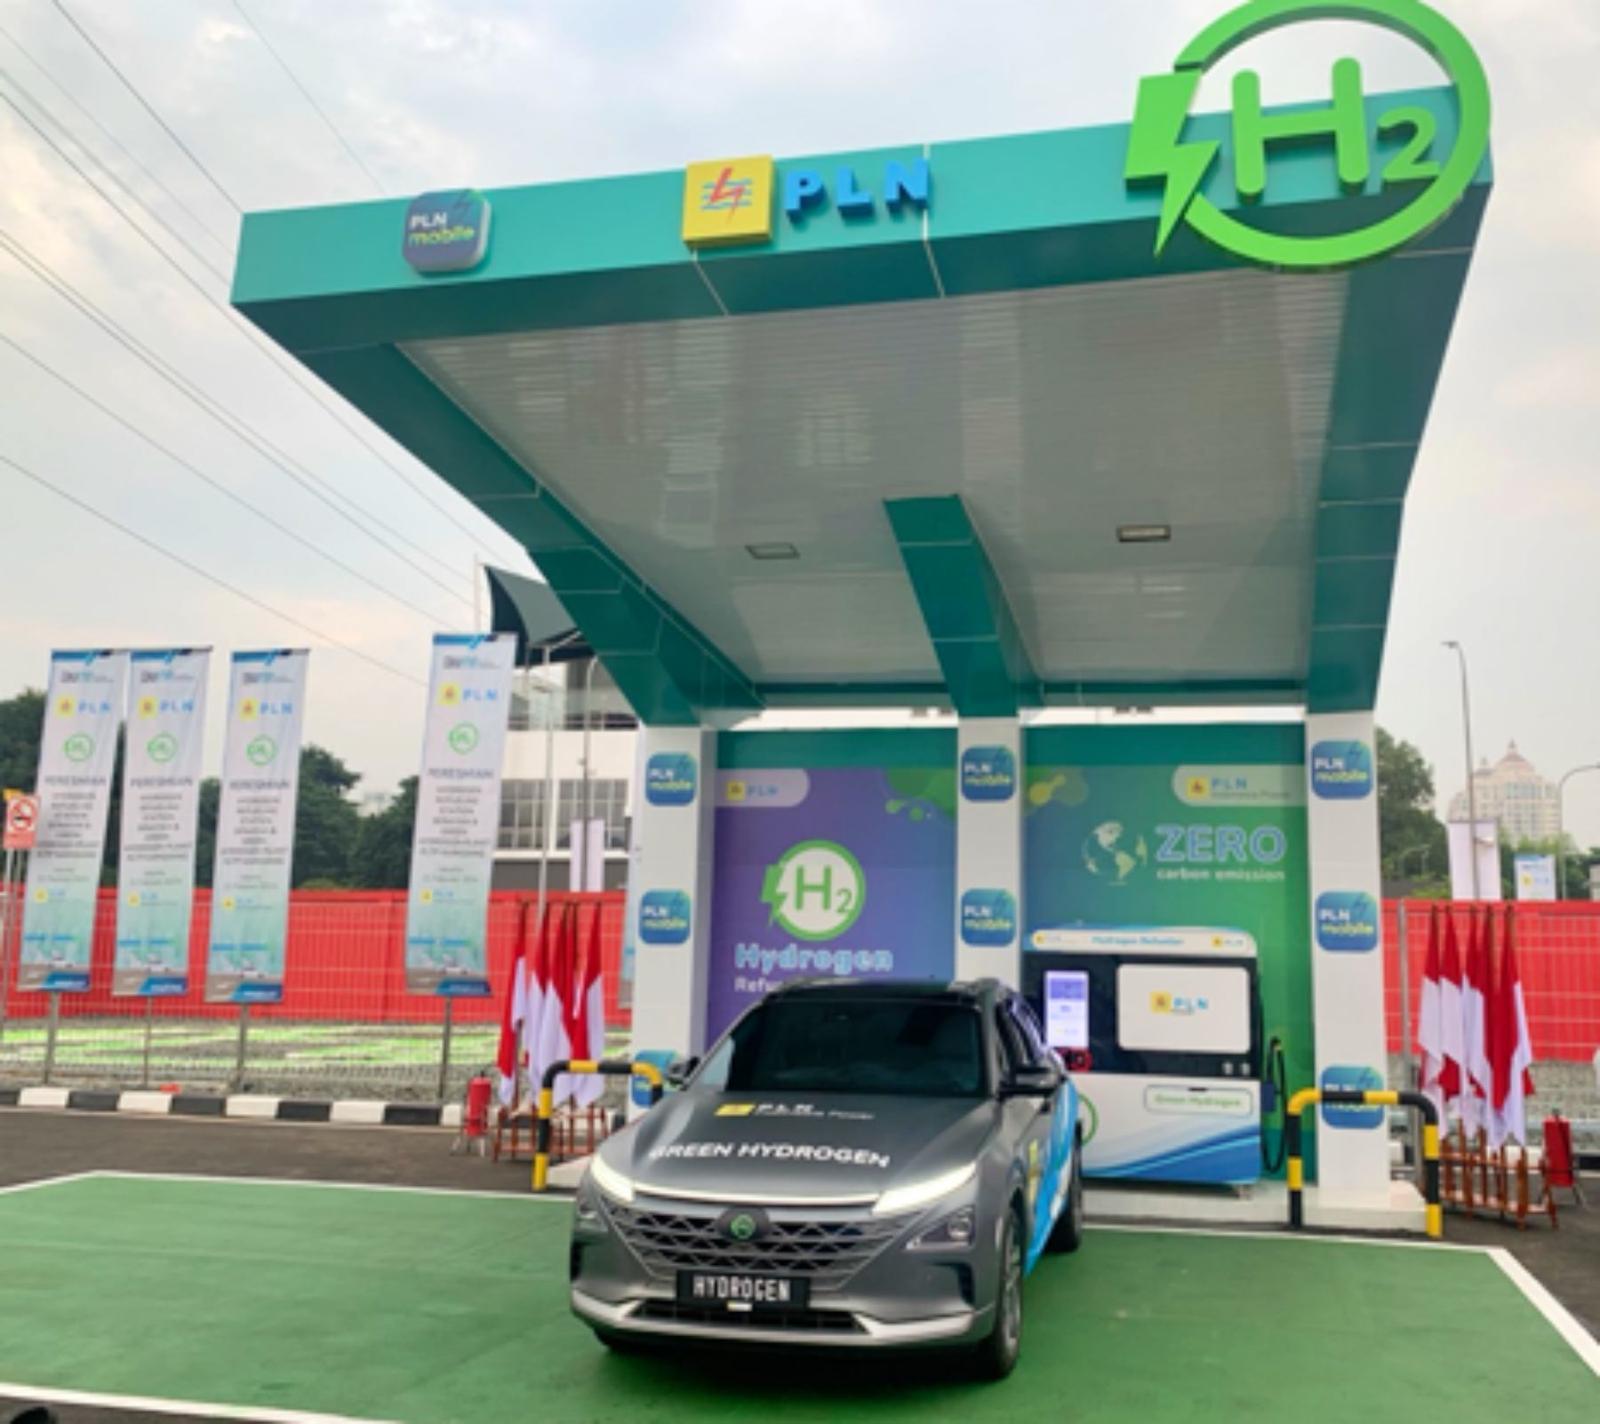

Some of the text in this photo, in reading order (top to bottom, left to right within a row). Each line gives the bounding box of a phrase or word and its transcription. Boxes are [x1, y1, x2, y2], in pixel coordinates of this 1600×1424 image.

[1232, 57, 1441, 195] H2
[784, 160, 930, 216] PLN
[411, 211, 447, 229] PLN
[409, 224, 475, 246] mobile
[964, 763, 991, 774] PLN
[1314, 757, 1344, 770] PLN
[649, 769, 673, 780] PLN
[966, 774, 1012, 787] mobile
[1316, 770, 1367, 784] mobile
[650, 779, 692, 792] mobile
[1211, 777, 1247, 790] PLN
[1155, 824, 1287, 863] ZERO
[1157, 867, 1286, 883] carbon emission
[794, 864, 853, 915] H2
[644, 906, 669, 917] PLN
[964, 906, 991, 917] PLN
[1319, 909, 1349, 922] PLN
[644, 917, 688, 931] mobile
[965, 918, 1012, 932] mobile
[1322, 922, 1374, 937] mobile
[734, 943, 894, 975] Hydrogen
[1173, 997, 1208, 1010] PLN
[647, 1142, 892, 1168] GREEN HYDROGEN
[692, 1275, 791, 1301] HYDROGEN
